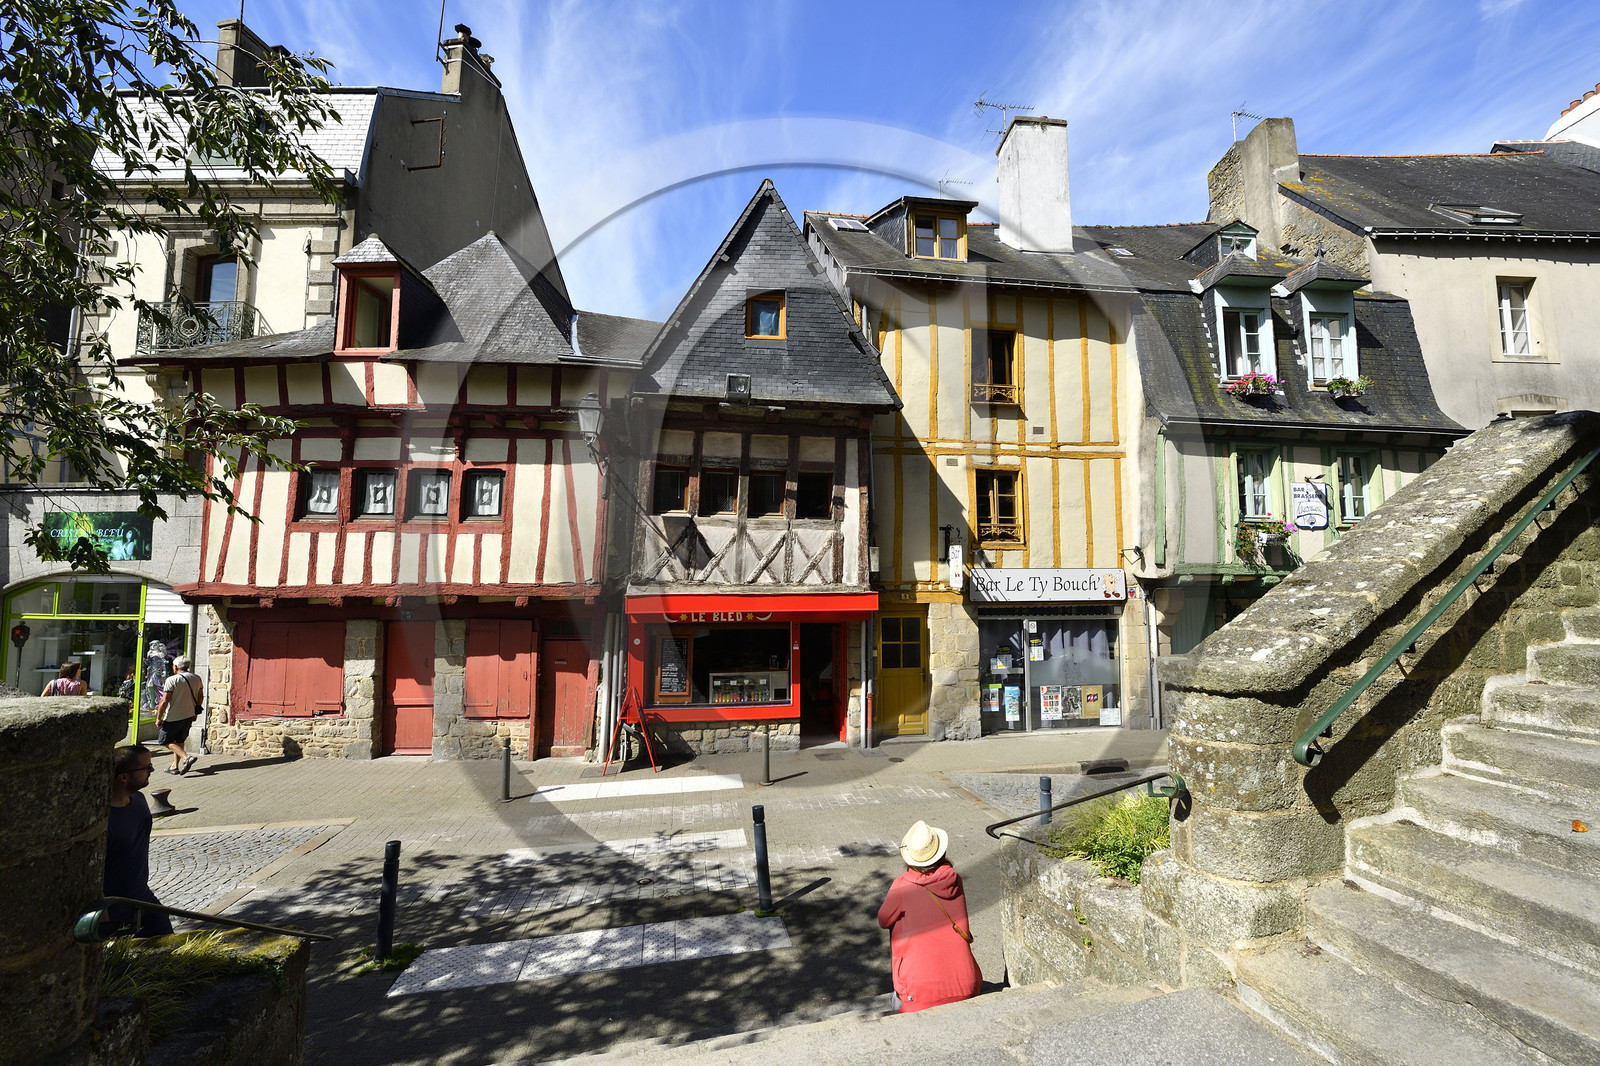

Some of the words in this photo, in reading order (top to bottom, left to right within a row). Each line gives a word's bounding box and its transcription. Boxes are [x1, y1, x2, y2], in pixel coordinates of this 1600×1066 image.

[96, 528, 124, 538] BLEU
[975, 577, 1000, 592] Bar
[1006, 577, 1024, 592] Le
[1029, 577, 1048, 598] Ty
[1053, 574, 1101, 591] Bouch'
[691, 612, 706, 622] LE
[713, 611, 743, 622] BLED
